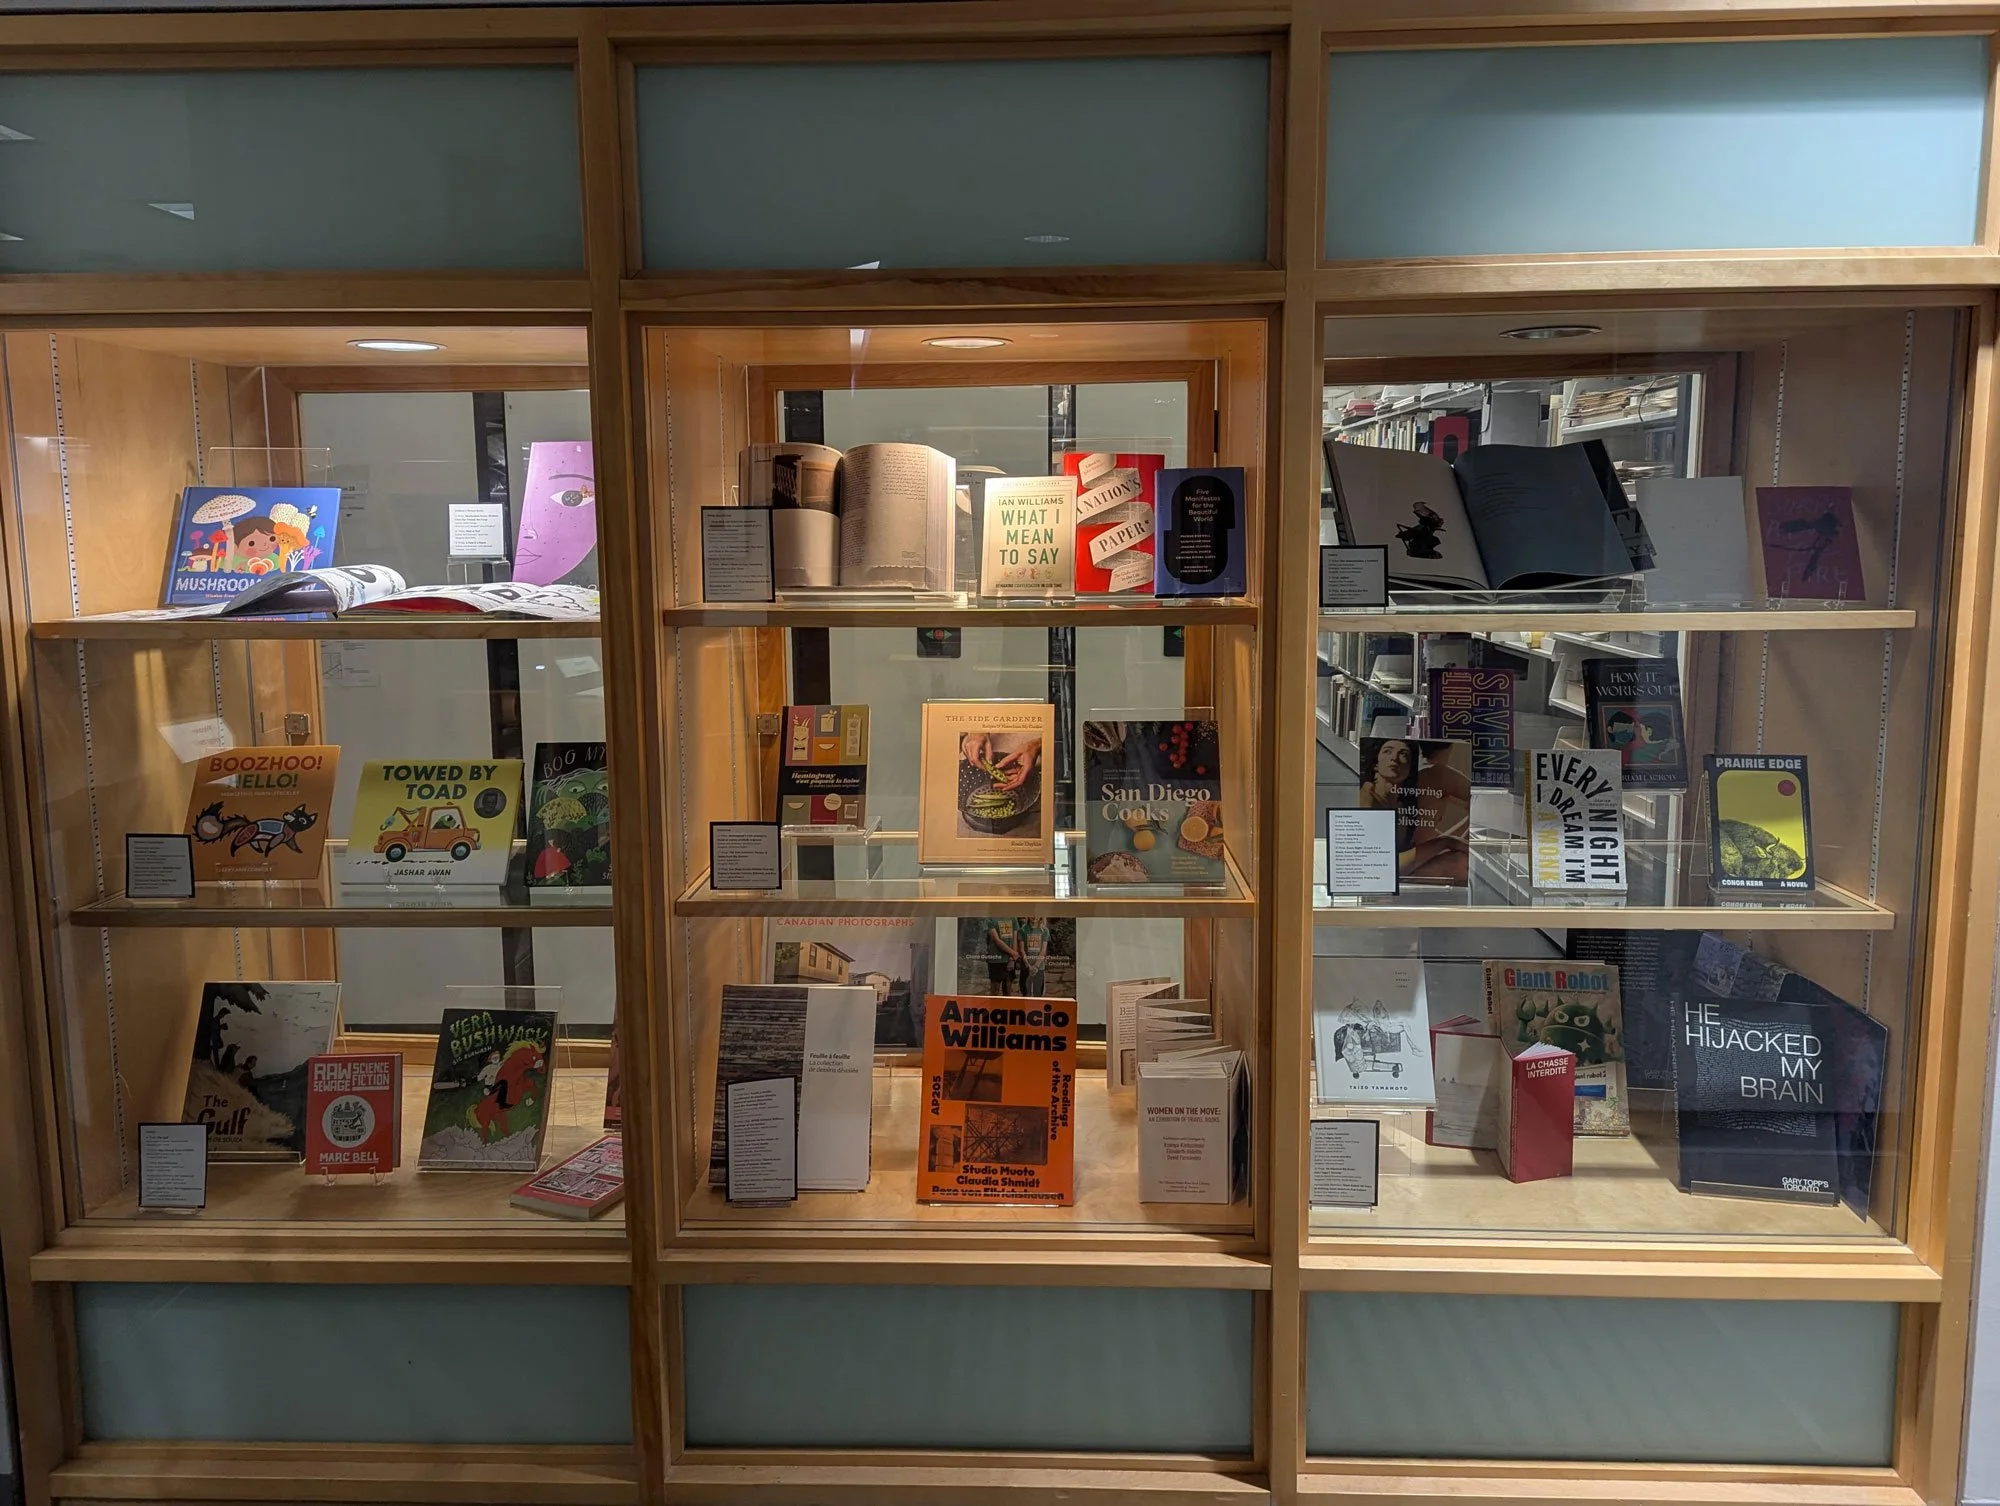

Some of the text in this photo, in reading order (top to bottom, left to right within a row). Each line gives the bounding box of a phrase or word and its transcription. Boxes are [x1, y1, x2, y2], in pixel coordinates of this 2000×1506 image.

[998, 497, 1064, 506] IAN WILLIAMS
[1083, 478, 1140, 510] NATION'S
[1001, 508, 1060, 526] WHAT I
[1006, 528, 1054, 546] MEAN
[999, 547, 1060, 566] TO SAY
[175, 576, 264, 592] MUSHROOM
[1610, 672, 1660, 683] HOW IT
[1596, 684, 1676, 697] WORKS OUT
[992, 715, 1043, 723] GARDENER
[1472, 672, 1510, 770] SEVEN
[210, 755, 323, 772] BOOZHOO!
[543, 748, 576, 779] BOG
[1715, 757, 1802, 770] PRAIRIE EDGE
[382, 765, 498, 781] TOWED BY
[791, 772, 836, 780] Hemingway
[406, 784, 468, 800] TOAD
[1101, 782, 1211, 807] San Diego
[1390, 784, 1443, 799] dayspring
[1102, 802, 1170, 822] Cooks
[1536, 753, 1614, 800] EVERY
[1588, 808, 1620, 884] NIGHT
[1536, 783, 1586, 883] I DREAM I'M
[1538, 828, 1560, 881] MONK
[394, 868, 452, 877] JASHAR AWAN
[1722, 878, 1764, 887] CONOR KERR
[776, 918, 915, 928] CANADIAN PHOTOGRAPHS
[1504, 968, 1610, 991] Giant Robot
[1486, 990, 1494, 1014] Robot
[940, 1000, 1070, 1028] Amancio
[1685, 1002, 1721, 1026] HE
[450, 1011, 494, 1038] VERA
[450, 1024, 548, 1058] BUSHWACK
[940, 1024, 1068, 1052] Williams
[1686, 1024, 1822, 1057] HIJACKED
[314, 1062, 353, 1081] RAW
[352, 1062, 390, 1074] SCIENCE
[1526, 1057, 1569, 1070] LA CHASSE
[1780, 1056, 1823, 1080] MY
[352, 1074, 390, 1086] FICTION
[1527, 1066, 1568, 1079] INTERDITE
[313, 1080, 351, 1092] SEWAGE
[1740, 1075, 1824, 1105] BRAIN
[203, 1094, 229, 1108] The
[930, 1075, 942, 1116] AP205
[1050, 1060, 1062, 1141] of the Archive
[1060, 1073, 1071, 1127] Readings
[1146, 1106, 1222, 1116] WOMEN ON THE MOVE:
[197, 1106, 252, 1136] Gulf
[320, 1152, 380, 1163] MARC BELL
[962, 1164, 1036, 1177] Studio Muoto
[956, 1175, 1041, 1188] Claudia Shmidt
[1782, 1176, 1830, 1188] GARY TOPP'S
[1782, 1182, 1820, 1193] TORONTO
[960, 1188, 982, 1197] von
